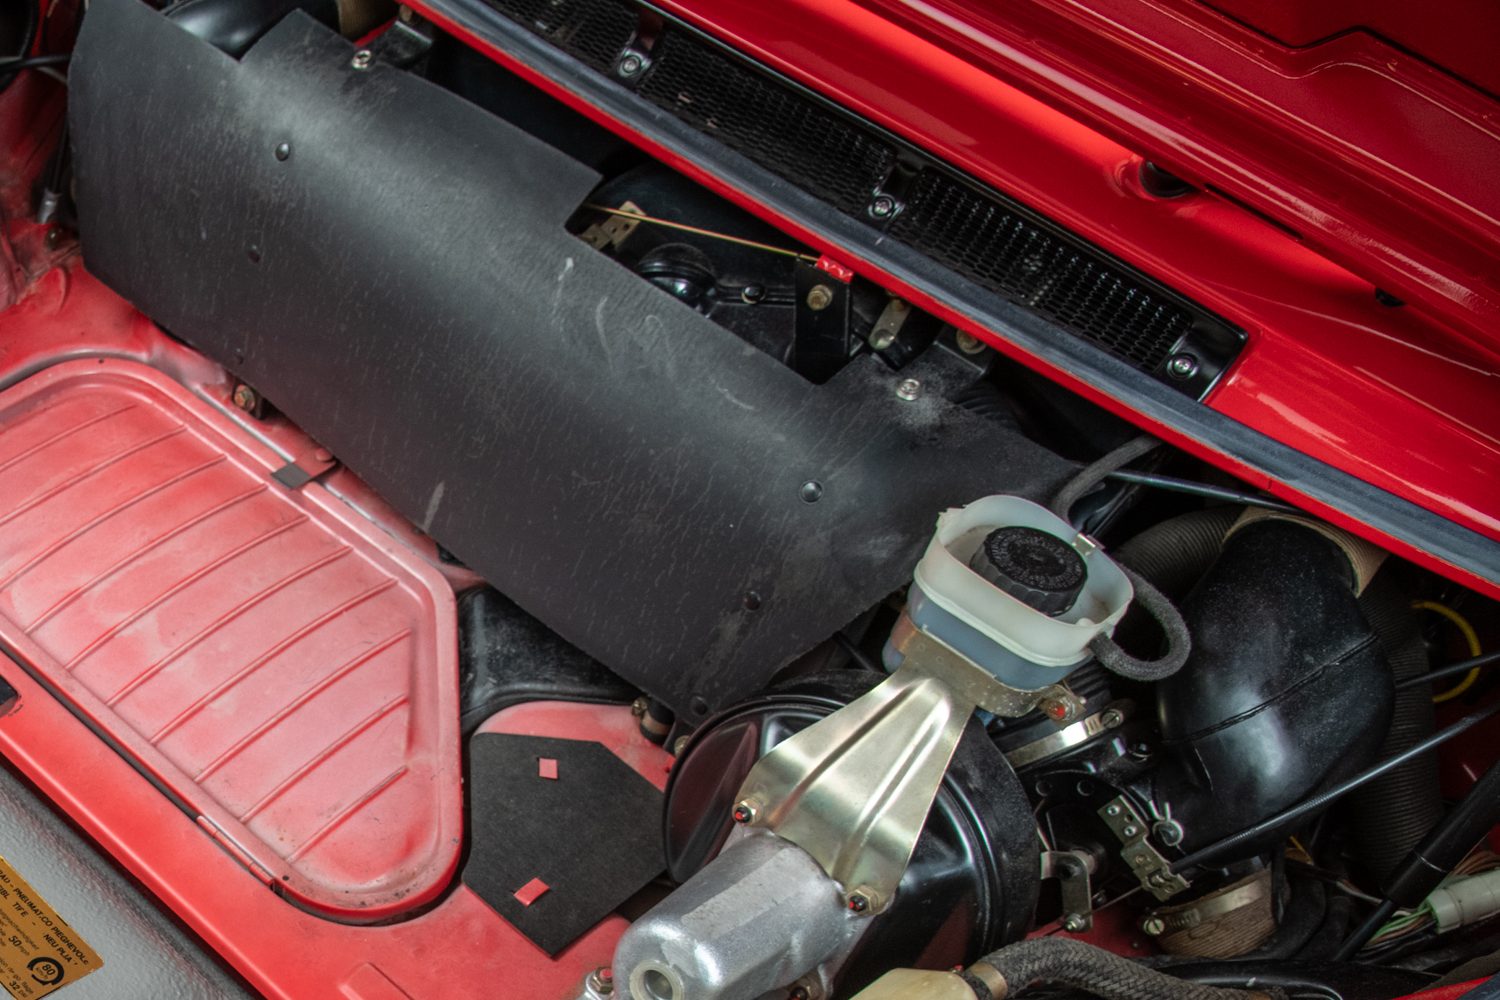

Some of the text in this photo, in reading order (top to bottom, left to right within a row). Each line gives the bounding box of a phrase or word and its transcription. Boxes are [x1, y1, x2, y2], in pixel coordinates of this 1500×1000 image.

[7, 934, 22, 947] 50
[40, 963, 56, 976] 80
[8, 980, 21, 990] 32
